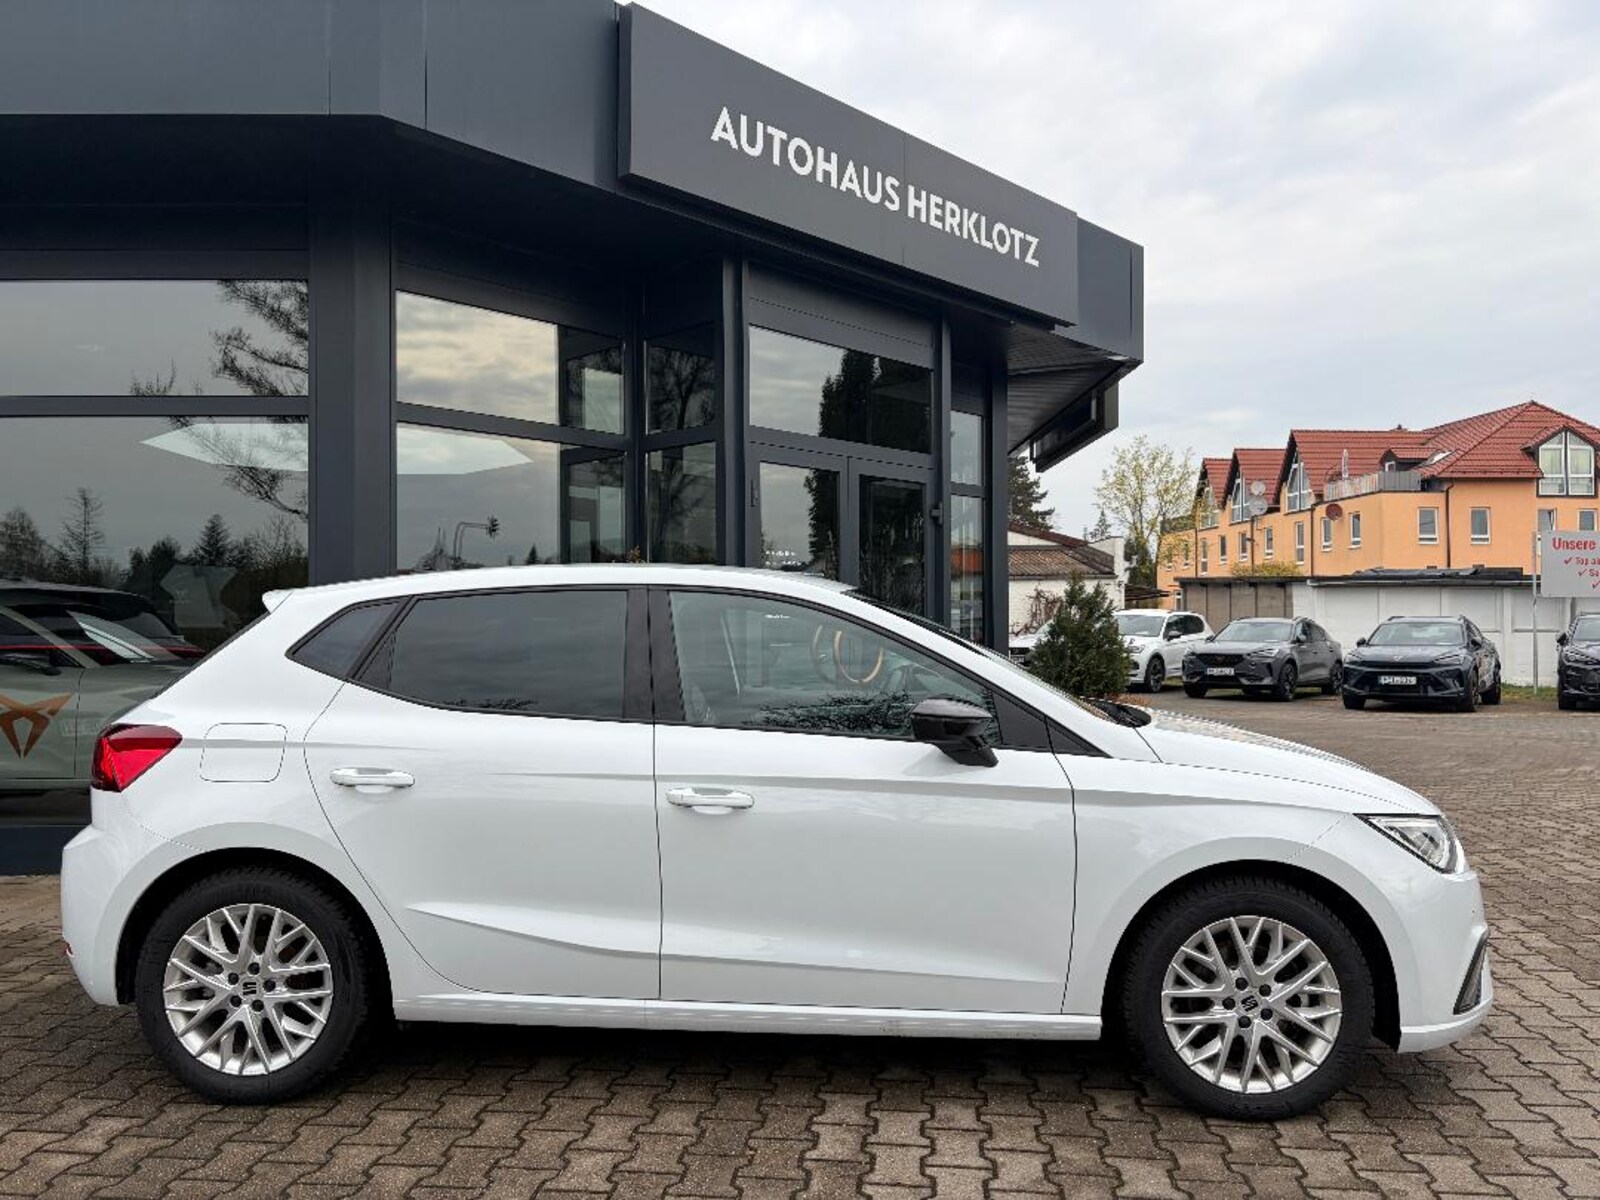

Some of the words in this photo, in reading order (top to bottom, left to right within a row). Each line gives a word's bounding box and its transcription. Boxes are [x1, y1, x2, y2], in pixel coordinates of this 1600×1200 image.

[710, 106, 900, 211] AUTOHAUS
[907, 184, 1040, 267] HERKLOTZ
[1552, 537, 1596, 550] Unsere
